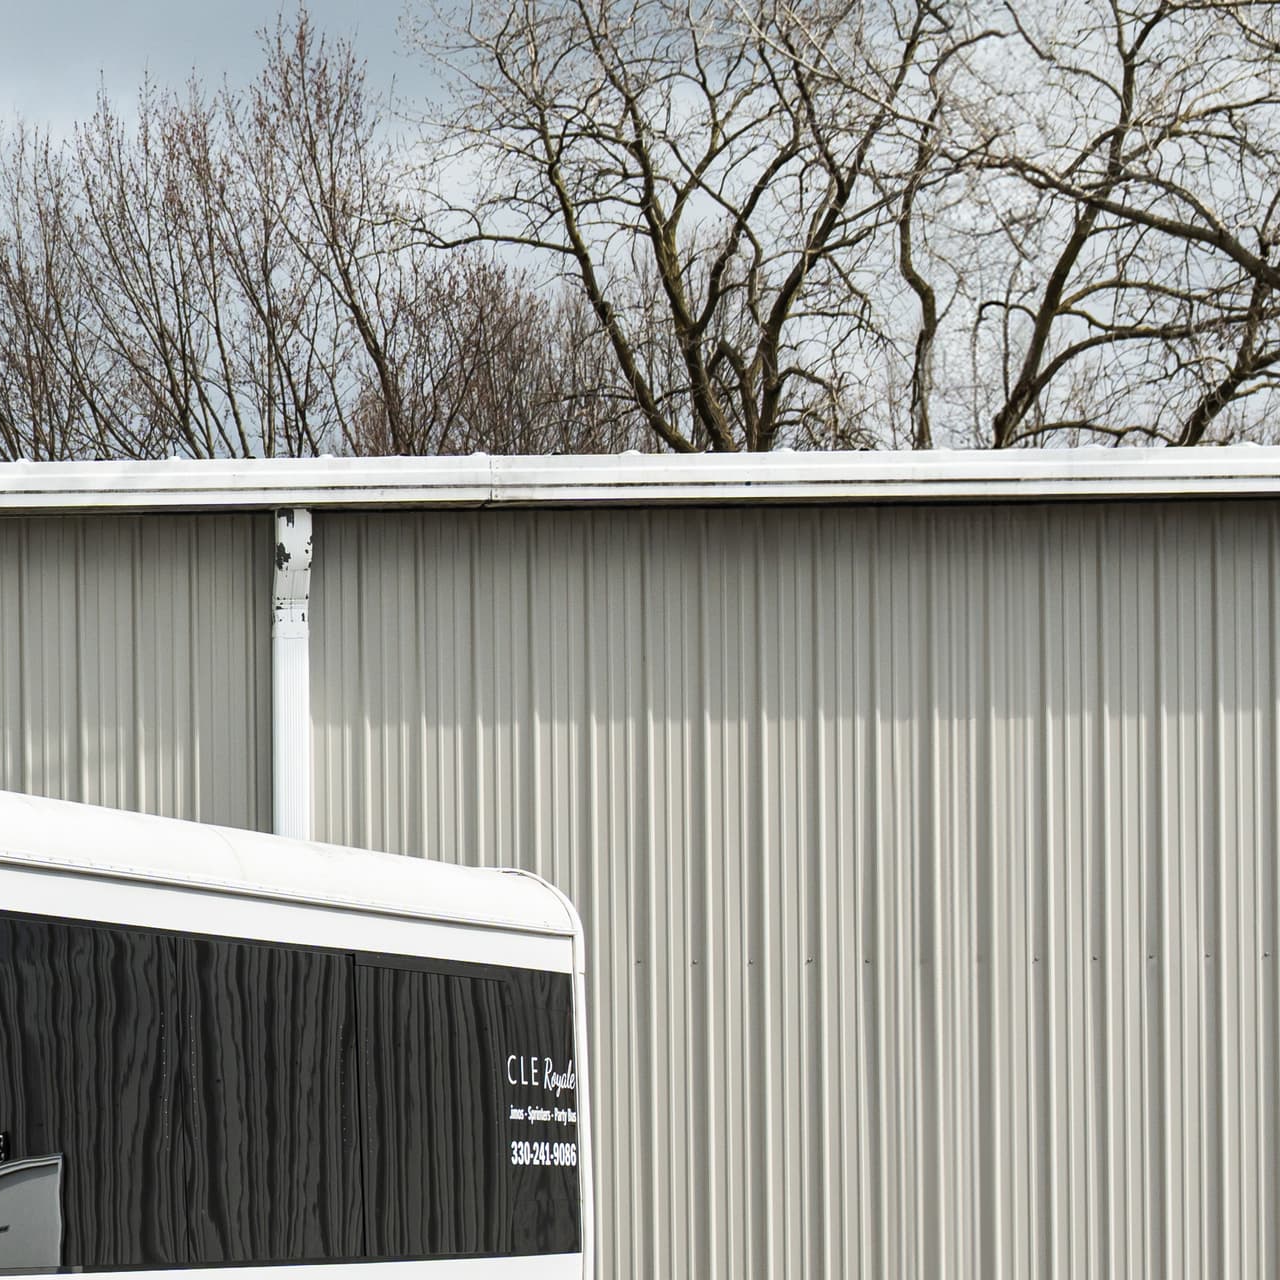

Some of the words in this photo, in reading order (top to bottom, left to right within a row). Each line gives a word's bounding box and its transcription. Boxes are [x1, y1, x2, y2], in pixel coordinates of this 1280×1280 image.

[507, 1054, 539, 1086] CLE
[544, 1057, 576, 1098] Royale
[528, 1105, 551, 1125] Sprinters
[554, 1106, 567, 1126] Party
[511, 1140, 577, 1167] 330-241-9086
